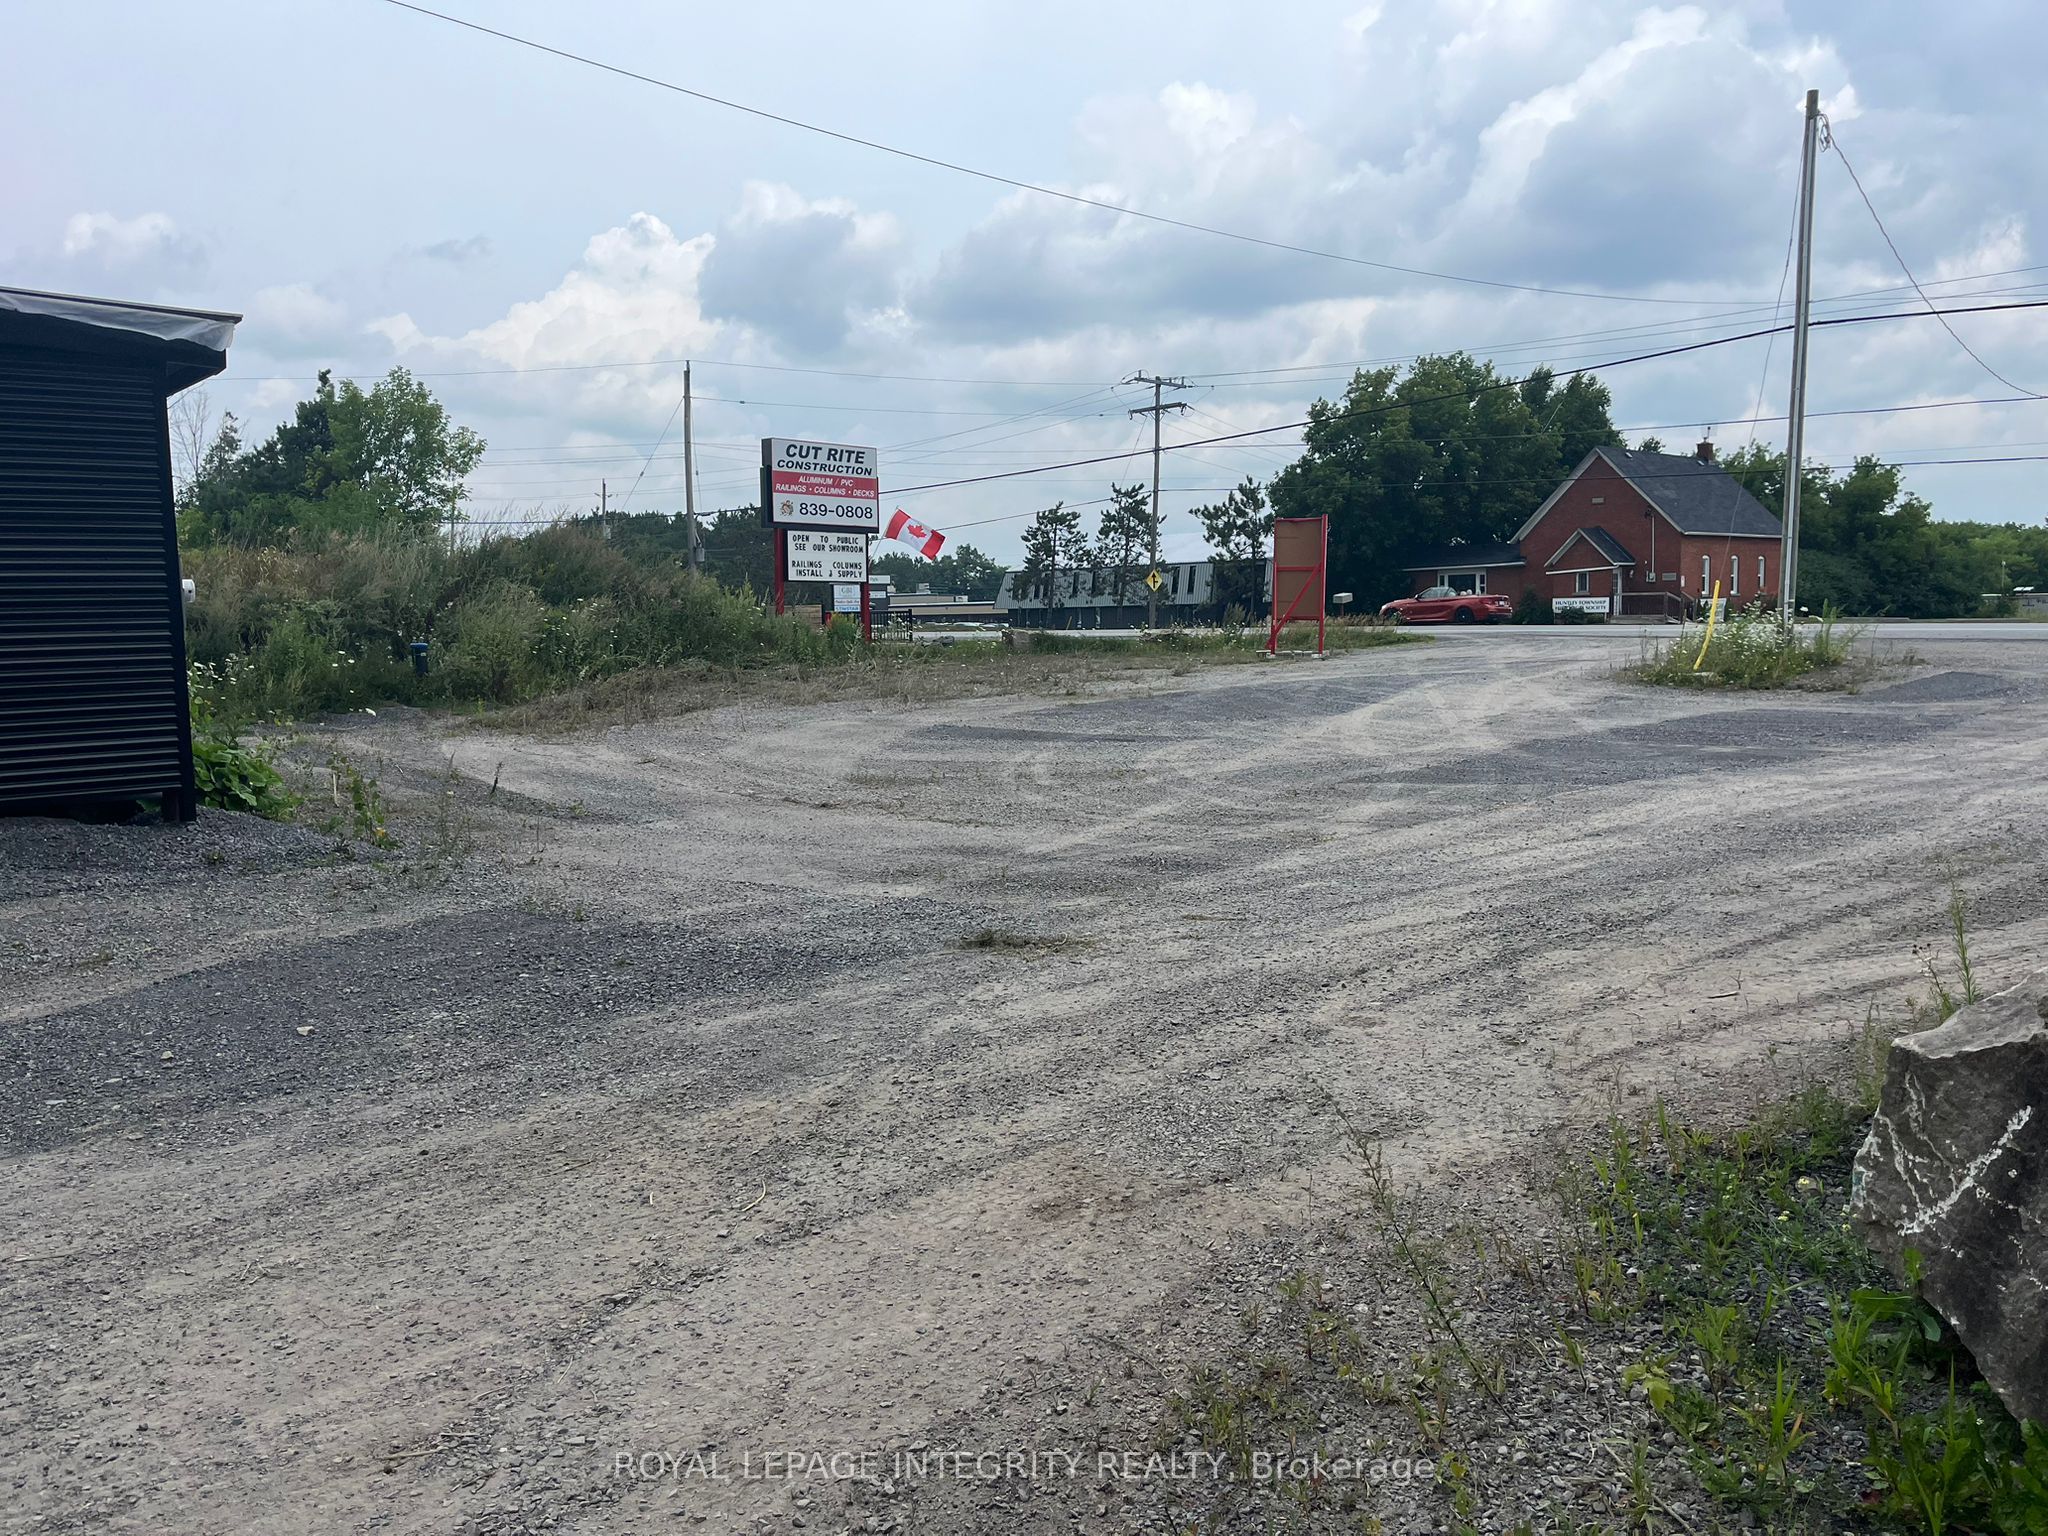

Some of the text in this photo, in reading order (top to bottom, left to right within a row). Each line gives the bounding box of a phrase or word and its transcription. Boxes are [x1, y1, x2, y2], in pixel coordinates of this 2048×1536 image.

[785, 443, 866, 464] CUT RITE
[777, 459, 873, 476] CONSTRUCTION
[798, 475, 834, 486] ALUMINUM
[840, 478, 854, 487] PVC
[775, 483, 875, 498] RAILINGS COLUMNS DECKS
[799, 502, 873, 519] 839-0808
[792, 534, 859, 545] OPEN TO PUBLIC
[794, 543, 864, 553] SEE OUR SHOWROOM
[791, 560, 862, 570] RAILINGS COLUMNS
[795, 569, 823, 577] INSTALL
[837, 570, 863, 578] SUPPLY
